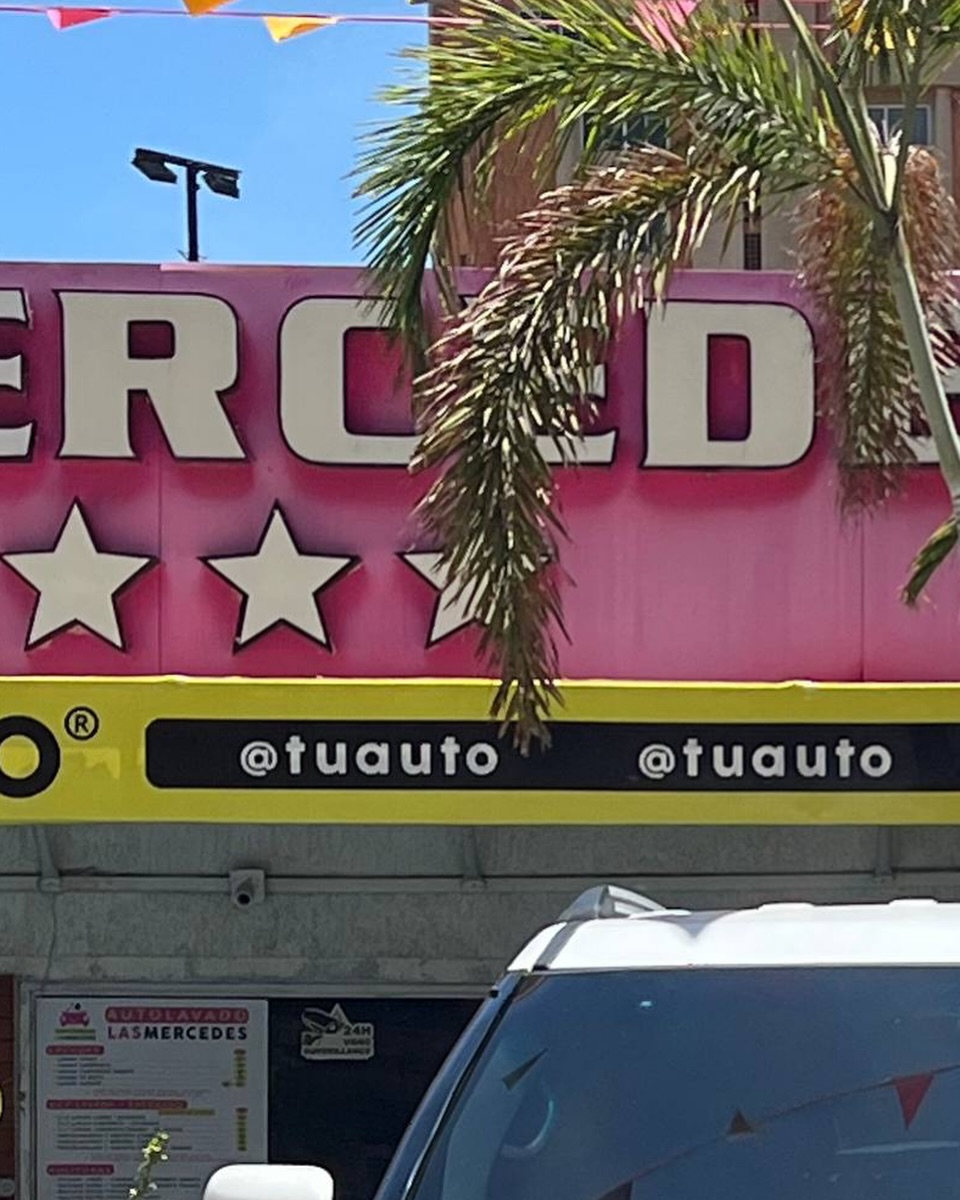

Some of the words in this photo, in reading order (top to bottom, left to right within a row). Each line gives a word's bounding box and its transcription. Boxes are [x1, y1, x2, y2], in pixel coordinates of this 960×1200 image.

[240, 735, 499, 777] @tuauto
[638, 738, 893, 778] @tuauto
[107, 1008, 248, 1021] AUTOLAVADO
[343, 1025, 371, 1036] 24H
